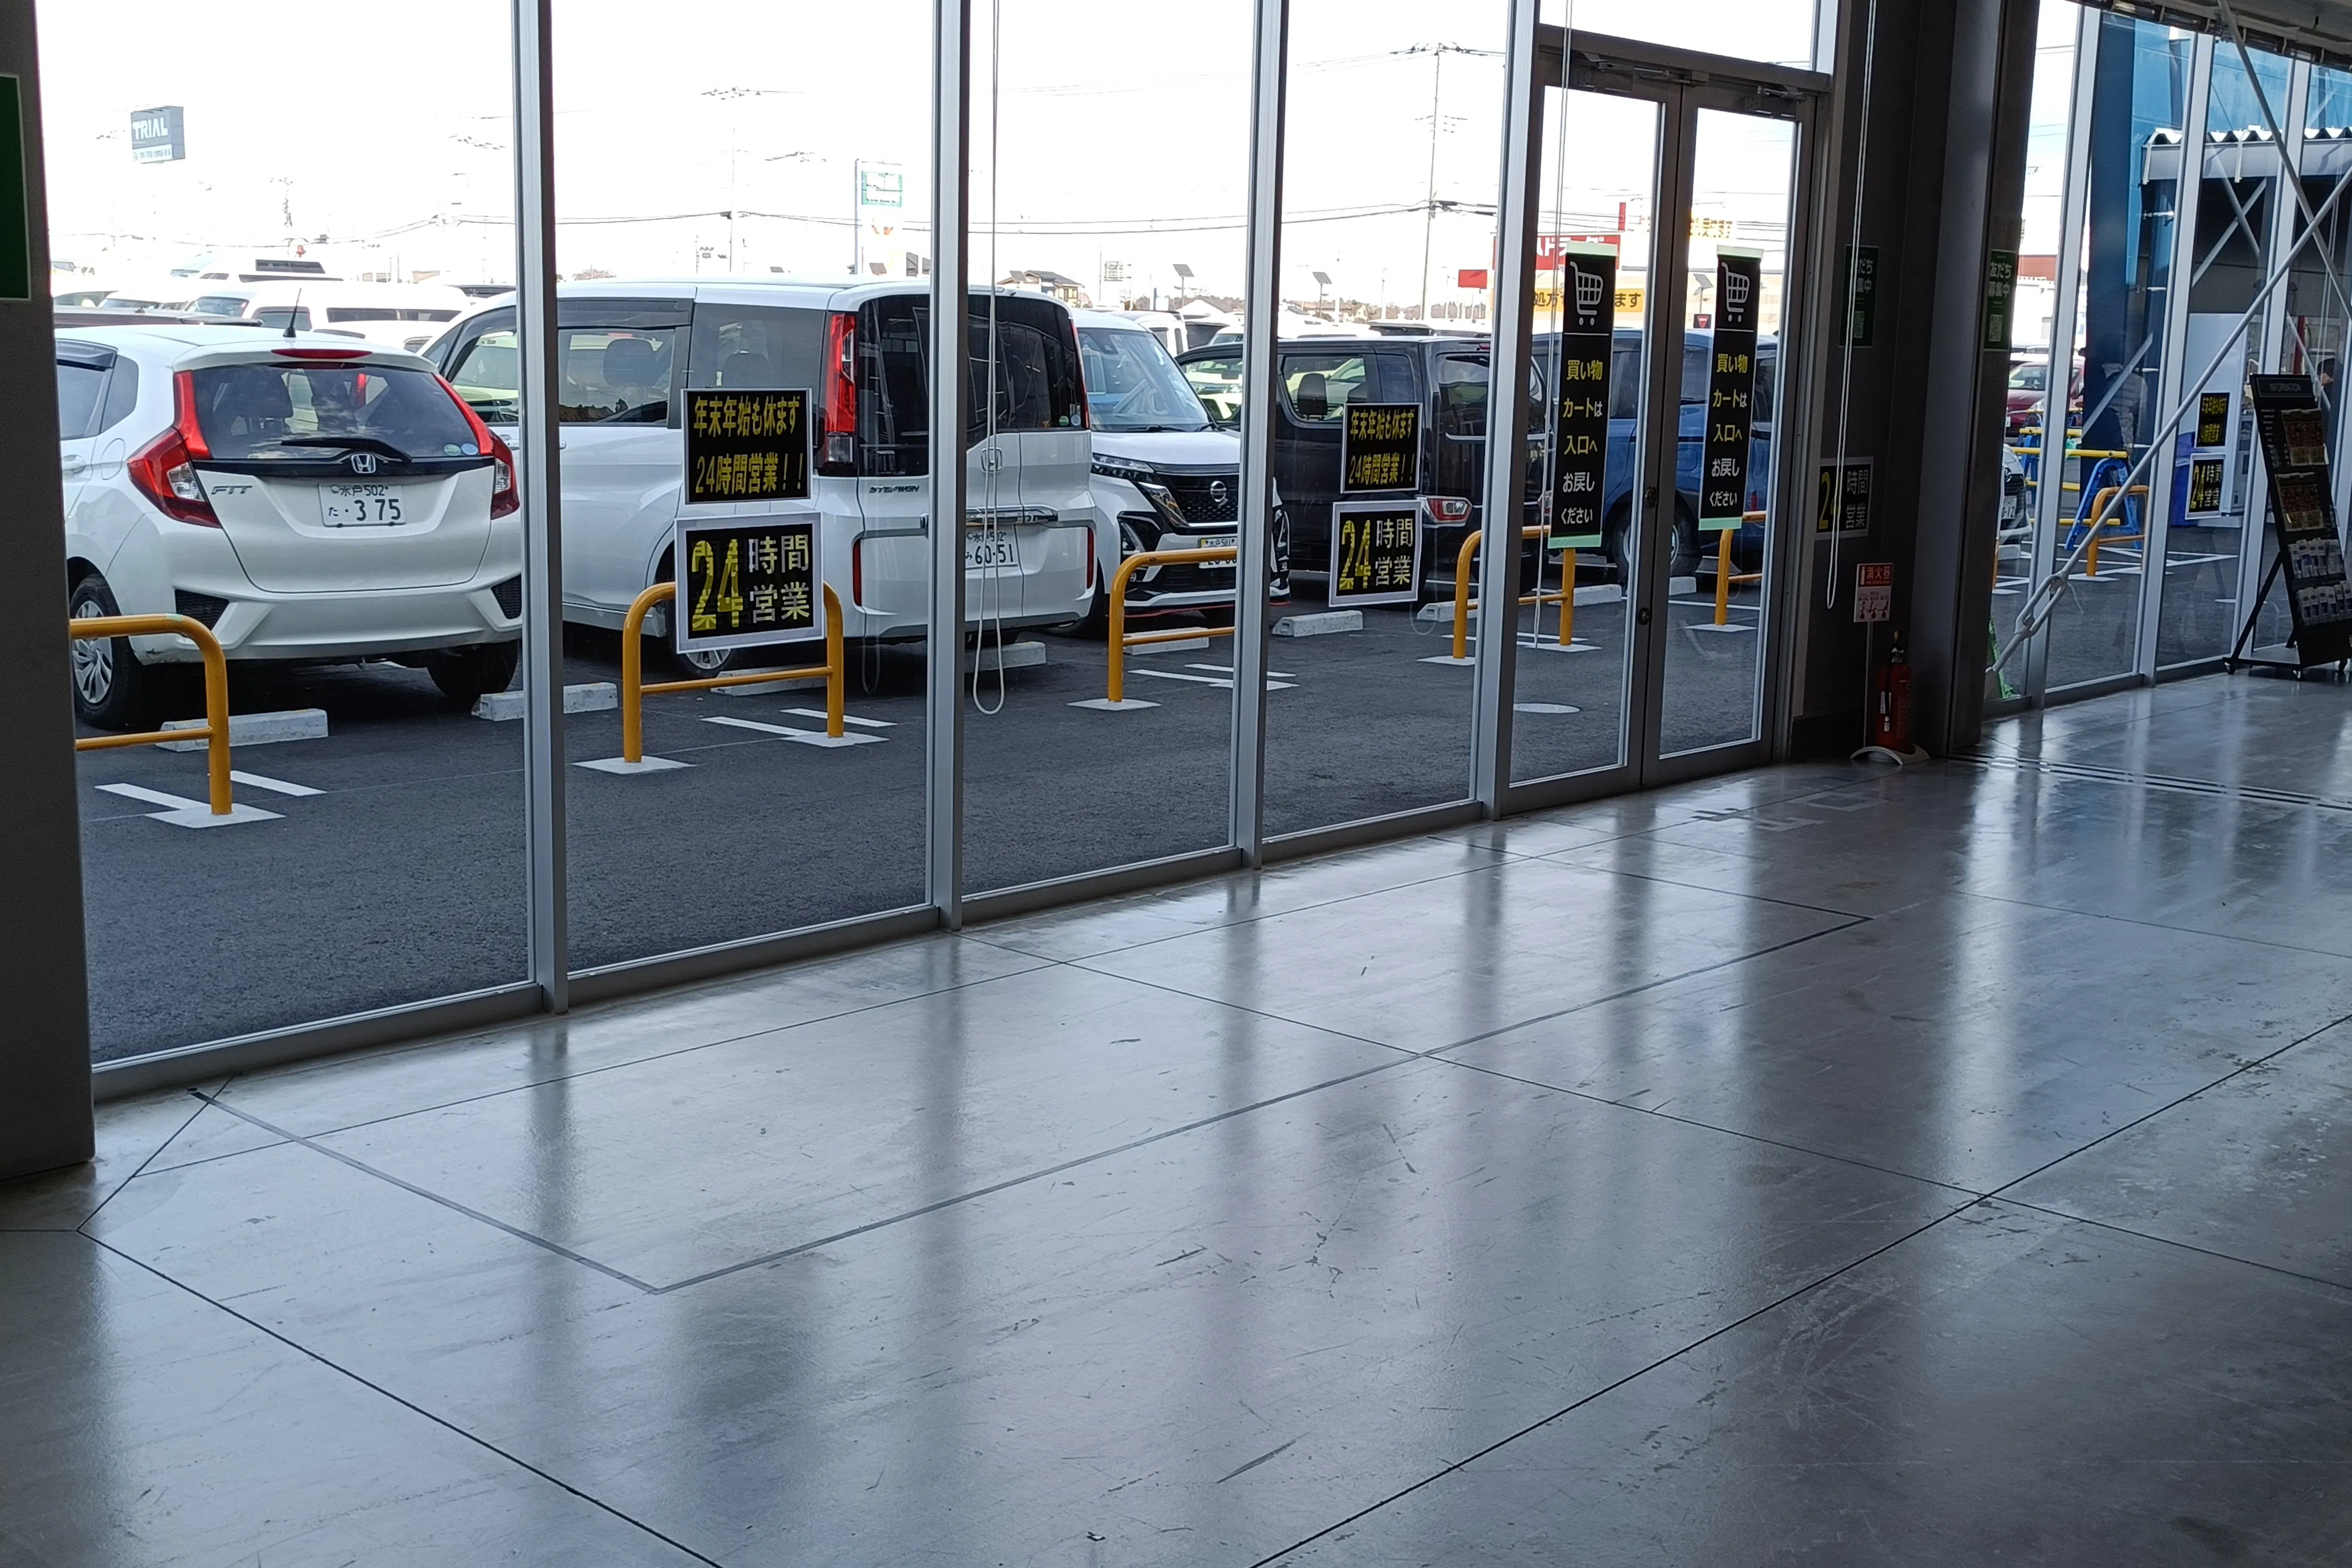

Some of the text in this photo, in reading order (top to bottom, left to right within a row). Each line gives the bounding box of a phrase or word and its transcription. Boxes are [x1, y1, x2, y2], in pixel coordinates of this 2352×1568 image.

[132, 117, 168, 140] TRIAL
[1989, 261, 2012, 279] 友だち
[1567, 360, 1603, 380] 買い物
[1716, 353, 1748, 373] 買い物
[1563, 397, 1602, 418] カートは
[1713, 389, 1747, 408] カートは
[694, 395, 800, 438] 年末年始も休まず
[1350, 408, 1415, 441] 年末年始も休まず
[1713, 424, 1742, 442] 入口へ
[1563, 435, 1598, 455] 入口へ
[1712, 458, 1740, 477] お戻し
[211, 485, 253, 495] FIT
[1563, 472, 1595, 492] お戻し
[1847, 469, 1869, 495] 時間
[1710, 491, 1737, 507] ください
[1561, 508, 1593, 524] ください
[1845, 502, 1866, 529] 営業
[1339, 518, 1414, 590] 24 時間
[1374, 555, 1412, 586] 営業
[691, 535, 809, 631] 24 時間
[749, 581, 810, 624] 営業
